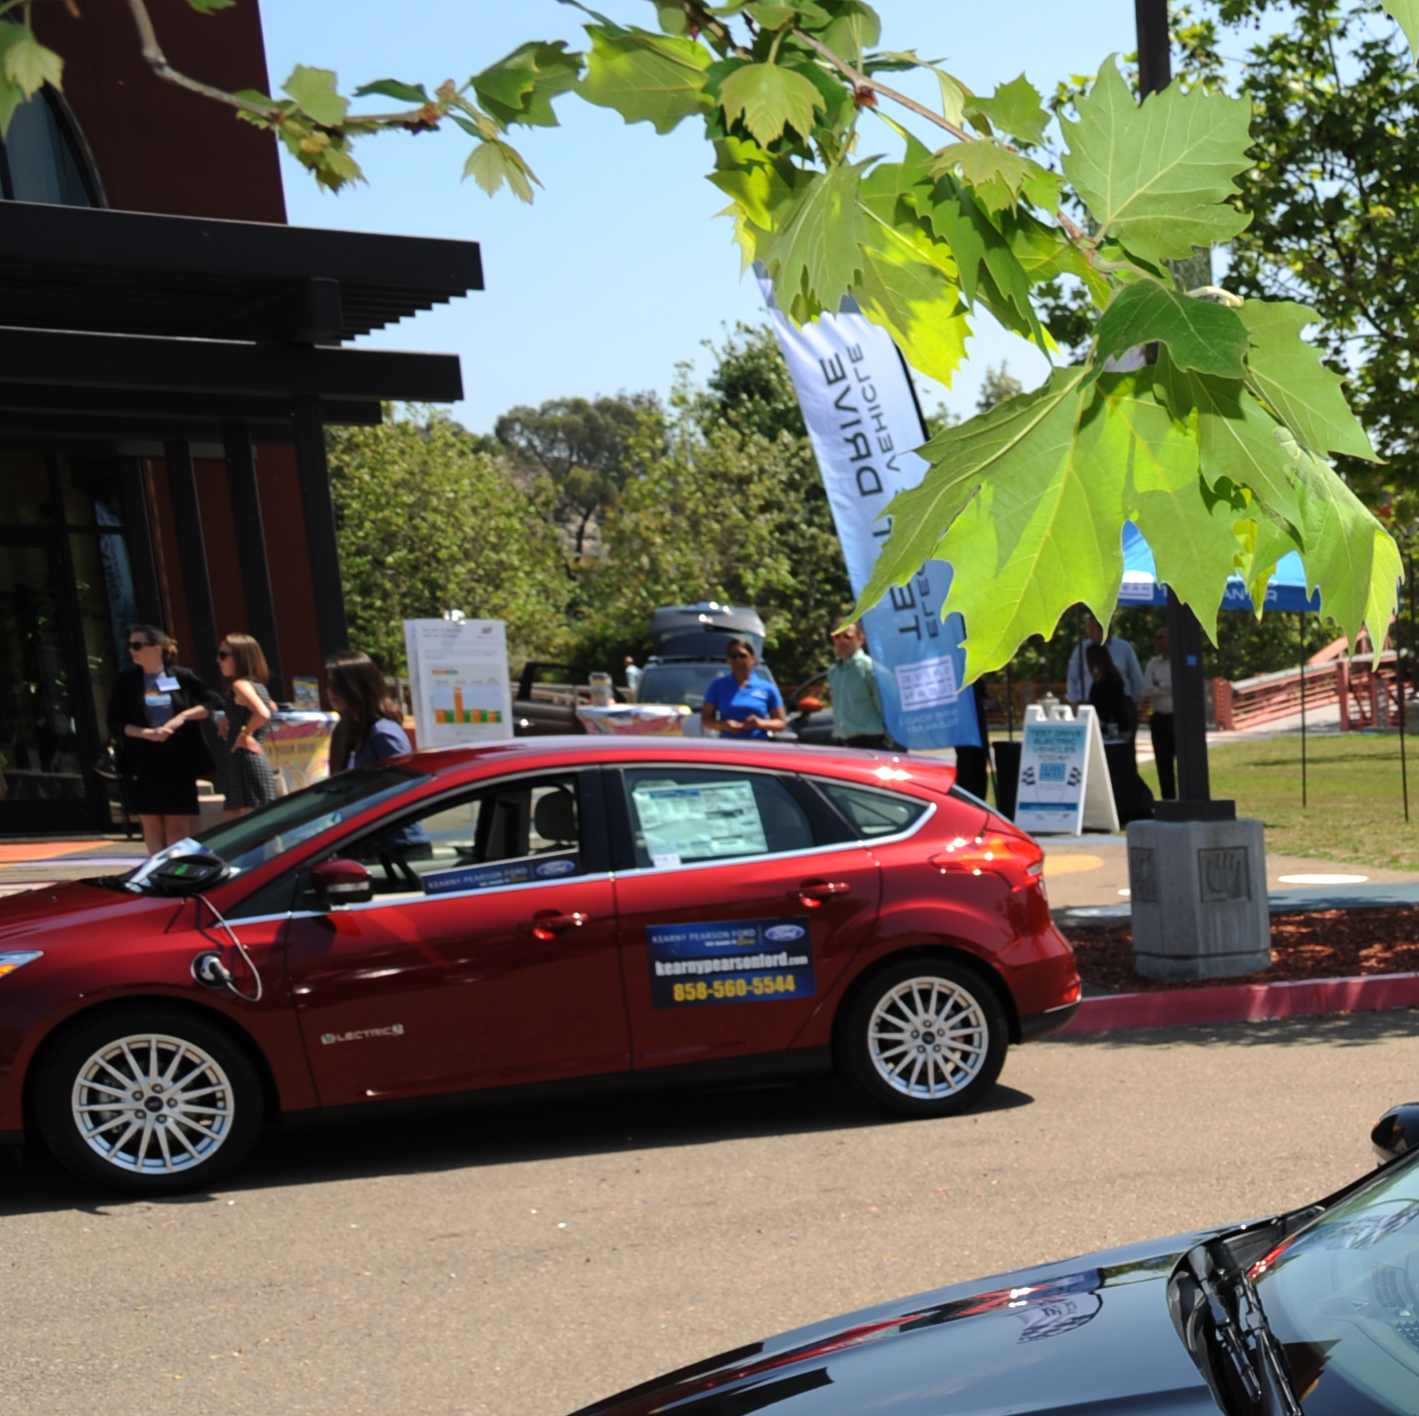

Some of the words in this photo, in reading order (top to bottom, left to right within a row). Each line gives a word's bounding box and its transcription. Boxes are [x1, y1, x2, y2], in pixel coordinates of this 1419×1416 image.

[652, 933, 687, 943] KEARNY
[689, 930, 730, 941] PEARSON
[732, 928, 757, 938] FORD
[654, 951, 809, 977] kearnypearsonford.com
[673, 974, 796, 1002] 858-560-5544
